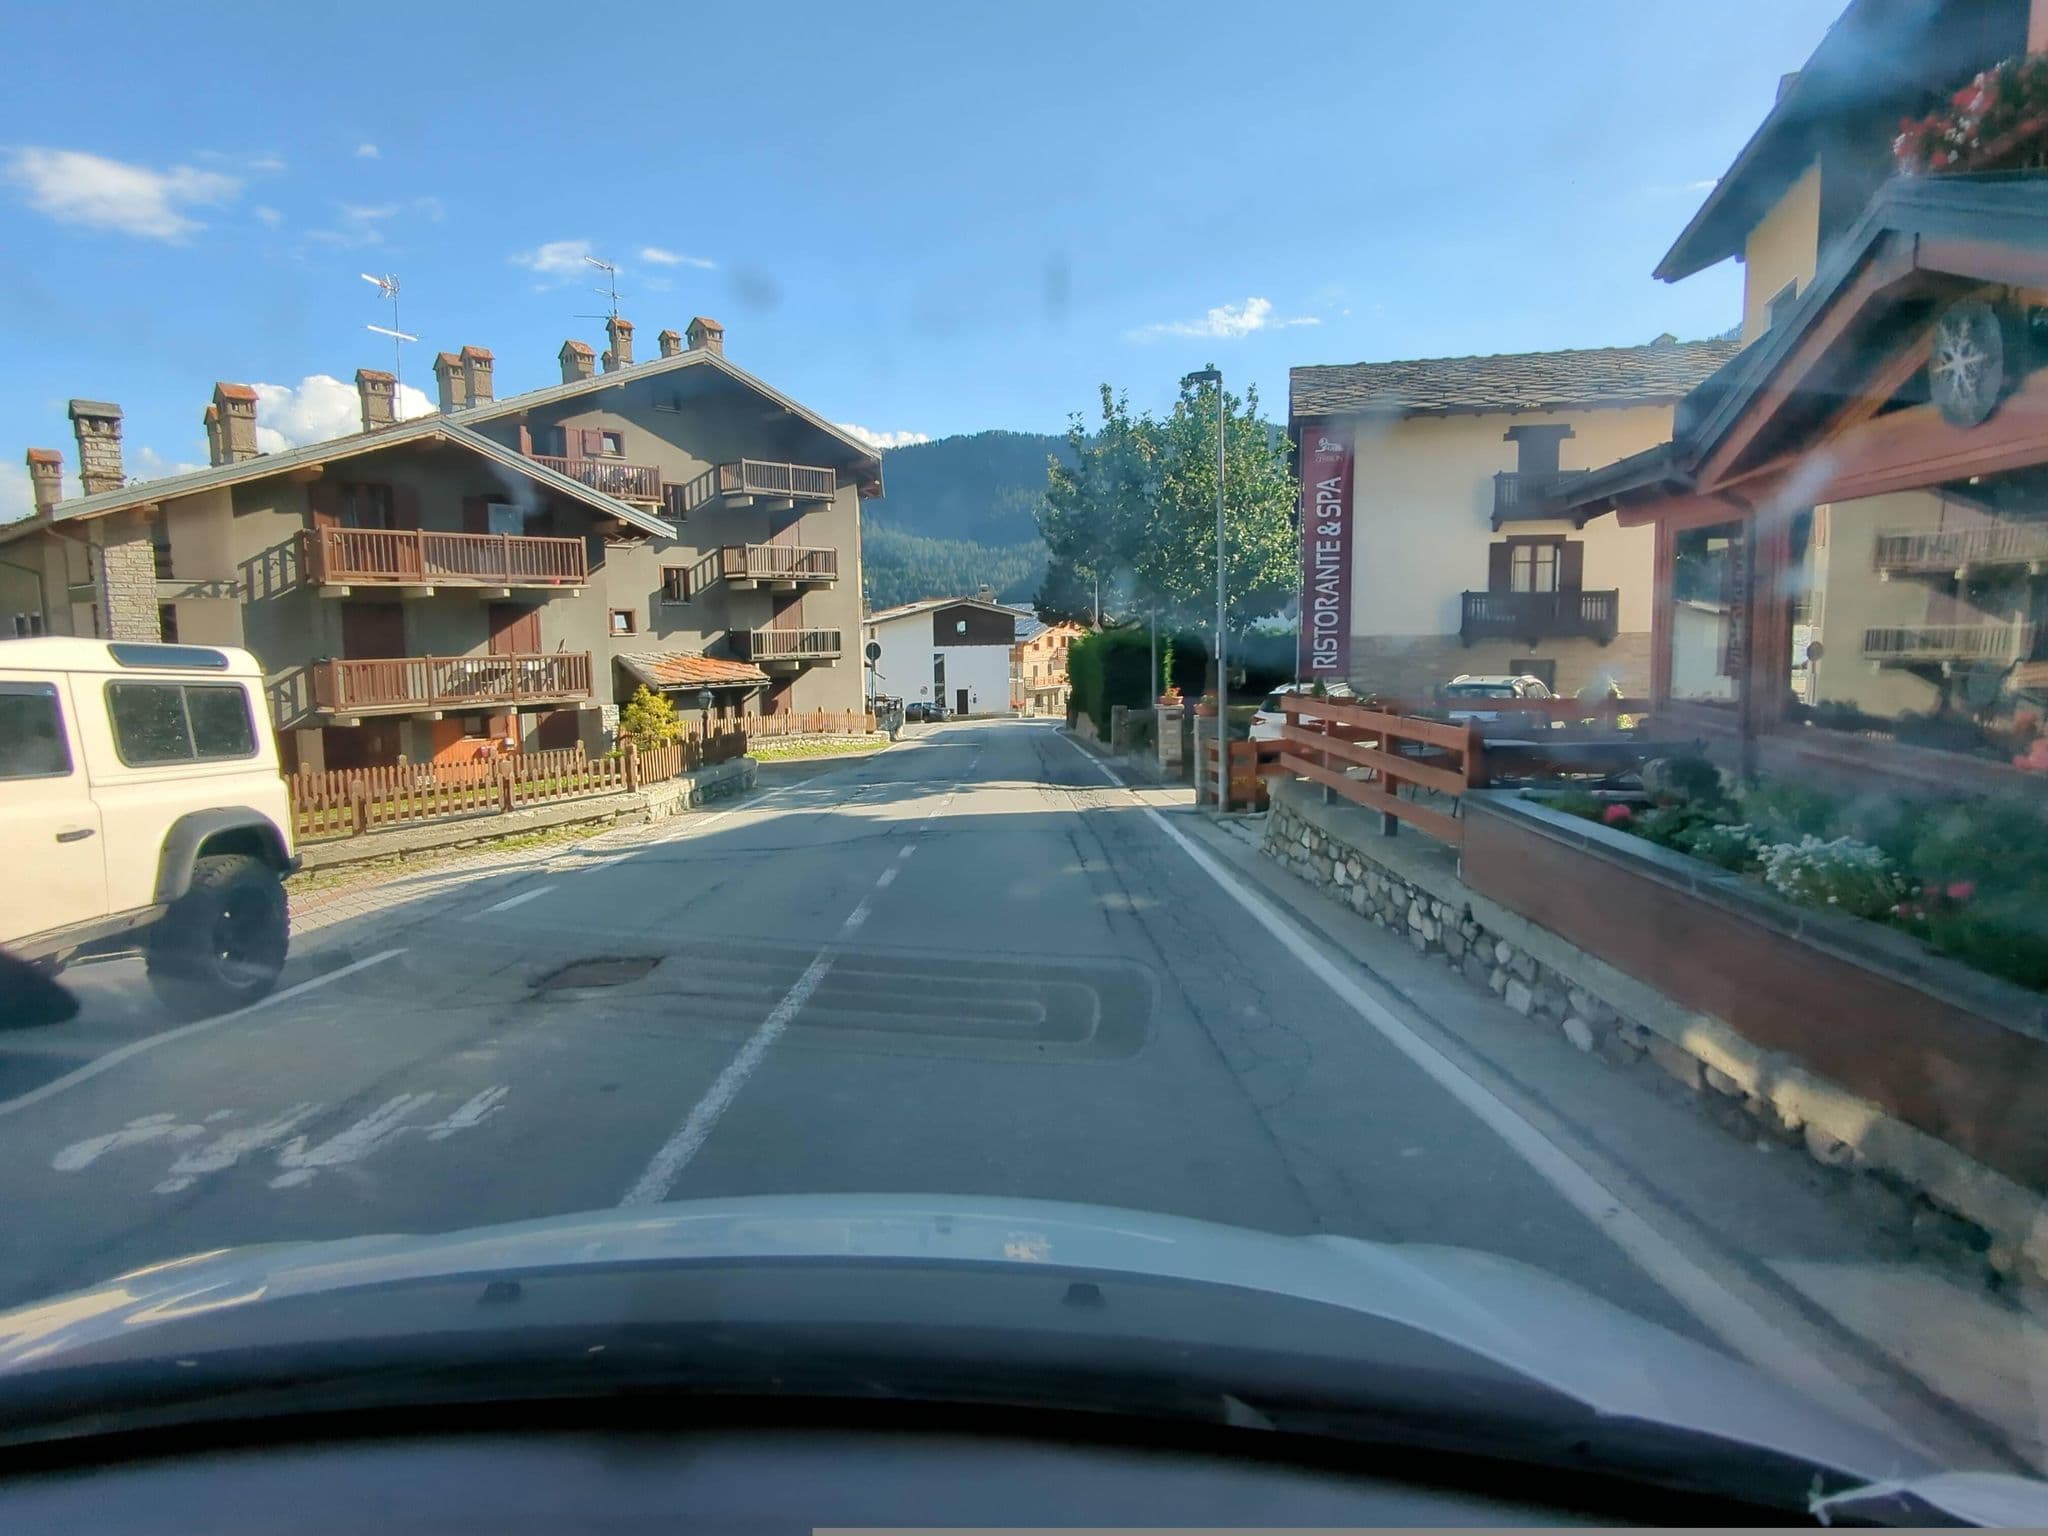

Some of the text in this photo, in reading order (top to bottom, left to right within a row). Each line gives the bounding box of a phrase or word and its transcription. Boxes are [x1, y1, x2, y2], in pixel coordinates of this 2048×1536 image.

[1316, 476, 1342, 518] SPA
[1316, 521, 1341, 536] &
[1312, 540, 1341, 669] RISTORANTE
